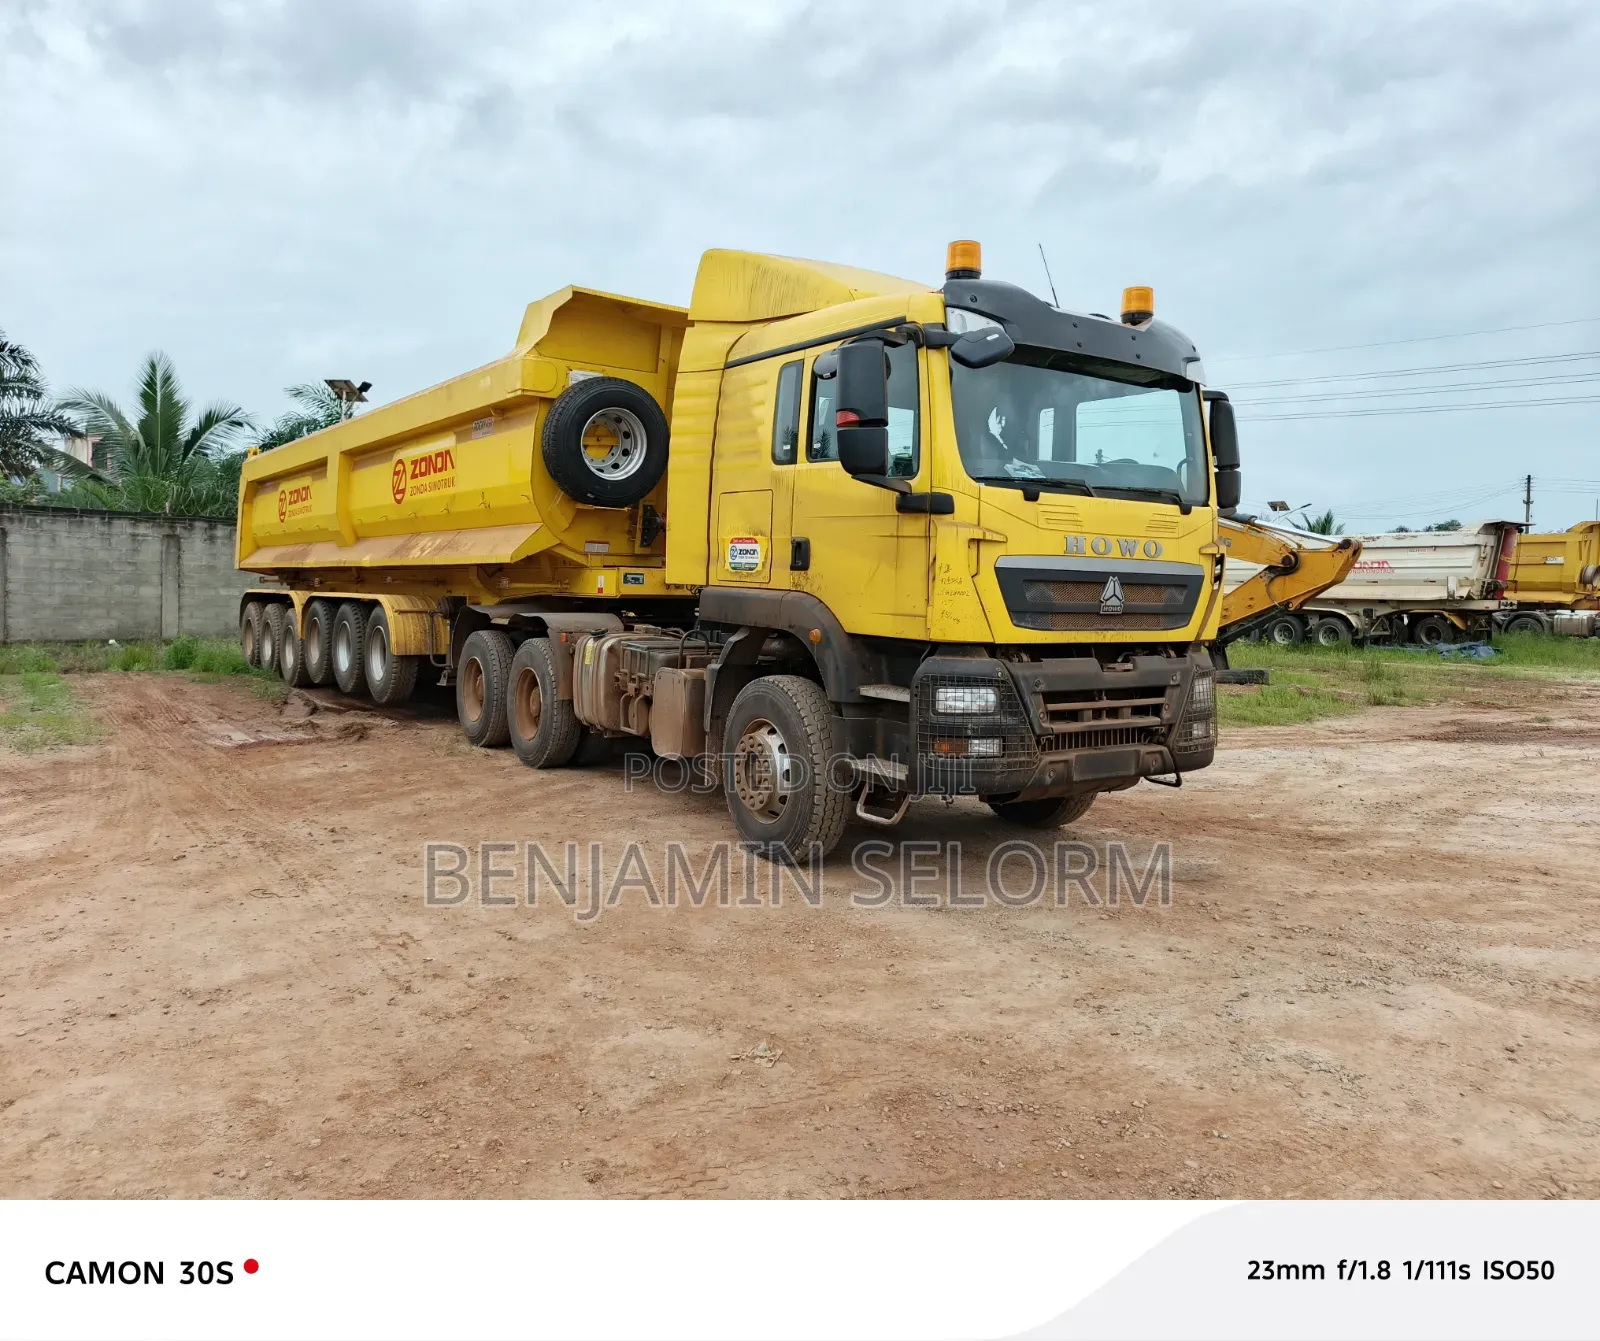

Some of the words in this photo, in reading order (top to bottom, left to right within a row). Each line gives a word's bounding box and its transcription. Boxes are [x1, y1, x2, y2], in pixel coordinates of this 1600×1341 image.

[410, 449, 455, 480] ZONDA
[288, 485, 312, 506] ZONDA
[410, 483, 427, 497] ZONDA
[428, 476, 456, 493] SINOTRUK
[738, 548, 759, 556] ZONDA
[1064, 535, 1163, 559] HOWO
[1352, 561, 1392, 569] ONDA
